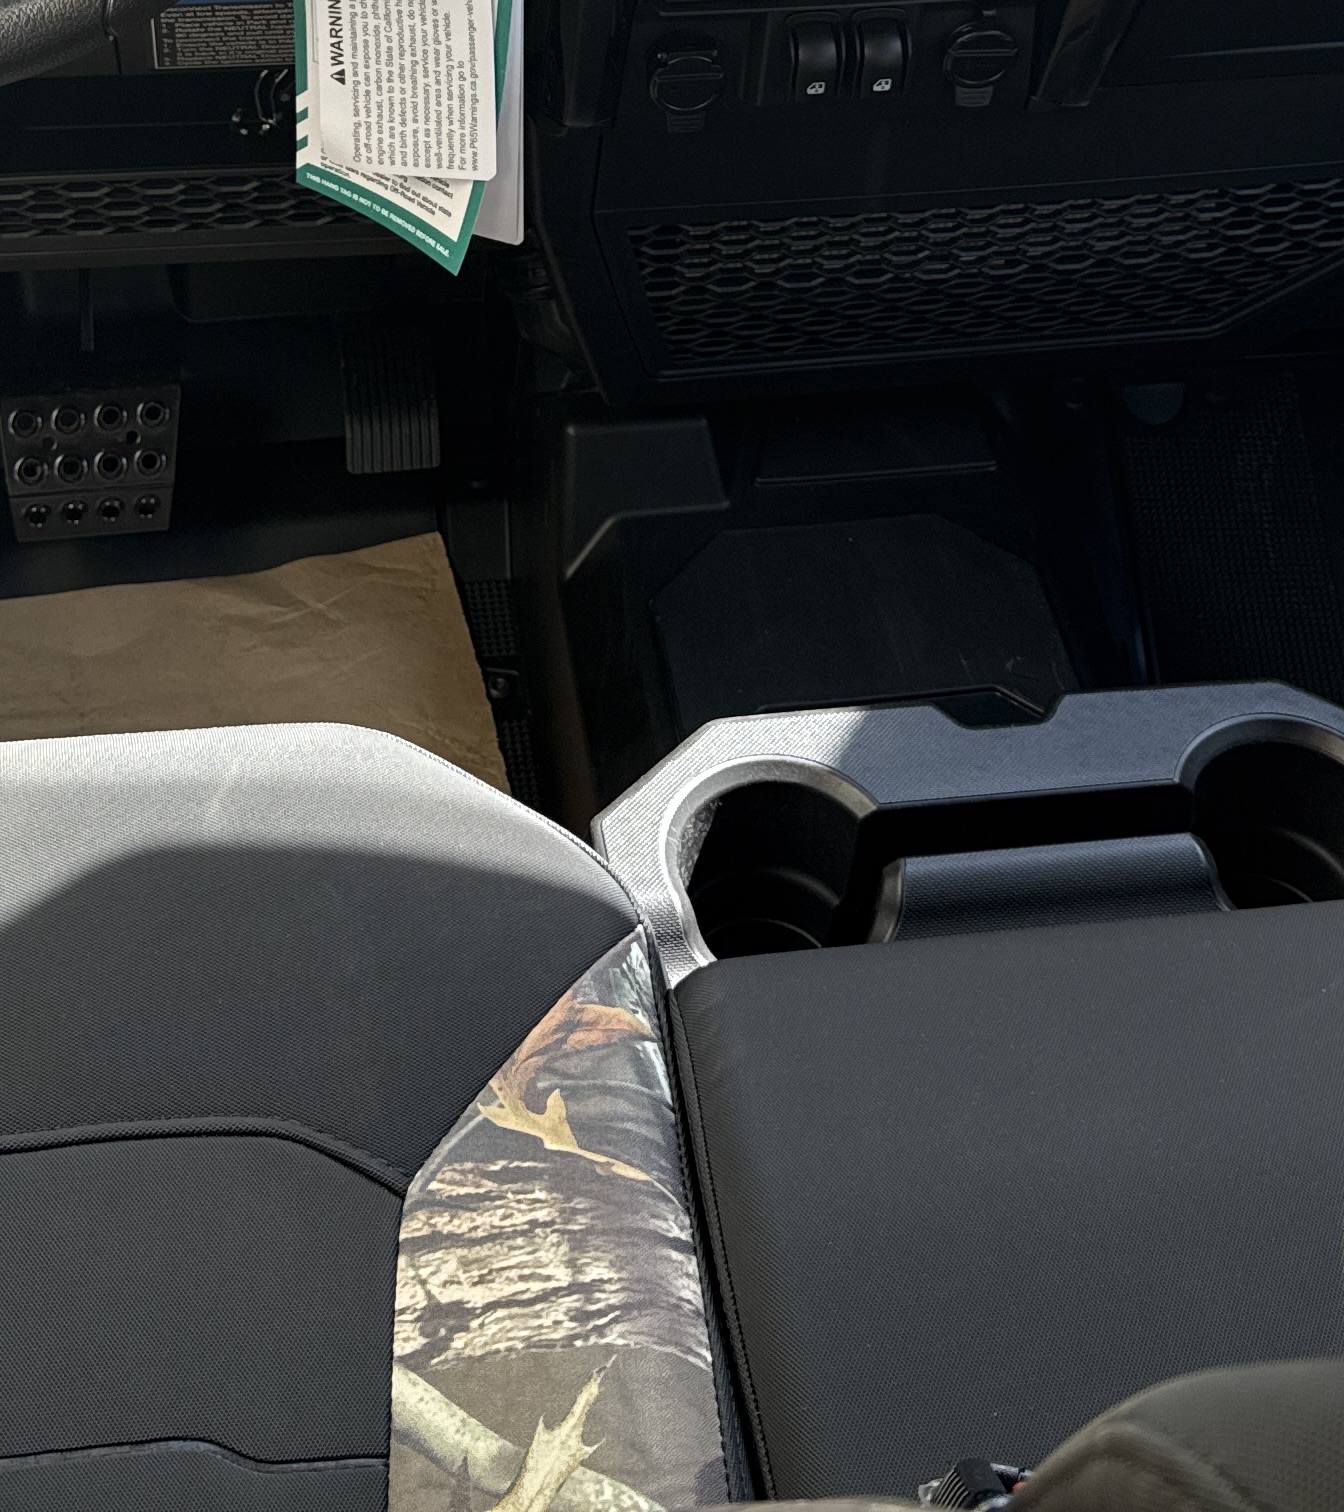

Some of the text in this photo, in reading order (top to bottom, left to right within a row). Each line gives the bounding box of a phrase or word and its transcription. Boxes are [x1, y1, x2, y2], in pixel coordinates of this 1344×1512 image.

[349, 12, 358, 59] maintaining
[362, 22, 370, 36] you
[396, 9, 406, 60] reproductive
[421, 28, 430, 46] your
[432, 19, 442, 45] gloves
[363, 39, 371, 69] expose
[385, 46, 393, 67] State
[421, 49, 429, 78] service
[445, 44, 454, 62] your
[350, 62, 358, 77] and
[374, 68, 382, 96] carbon
[386, 70, 394, 83] the
[398, 62, 406, 84] other
[409, 60, 419, 98] breathing
[433, 70, 441, 86] and
[445, 65, 454, 101] servicing
[352, 80, 361, 117] servicing
[363, 89, 371, 118] vehicle
[387, 96, 395, 123] known
[399, 97, 407, 128] defects
[410, 101, 418, 124] avoid
[446, 104, 454, 126] when
[364, 121, 372, 153] off-road
[399, 130, 407, 148] birth
[446, 128, 456, 169] frequently
[376, 137, 386, 165] engine
[399, 151, 407, 167] and
[423, 140, 432, 168] except
[458, 156, 466, 170] For
